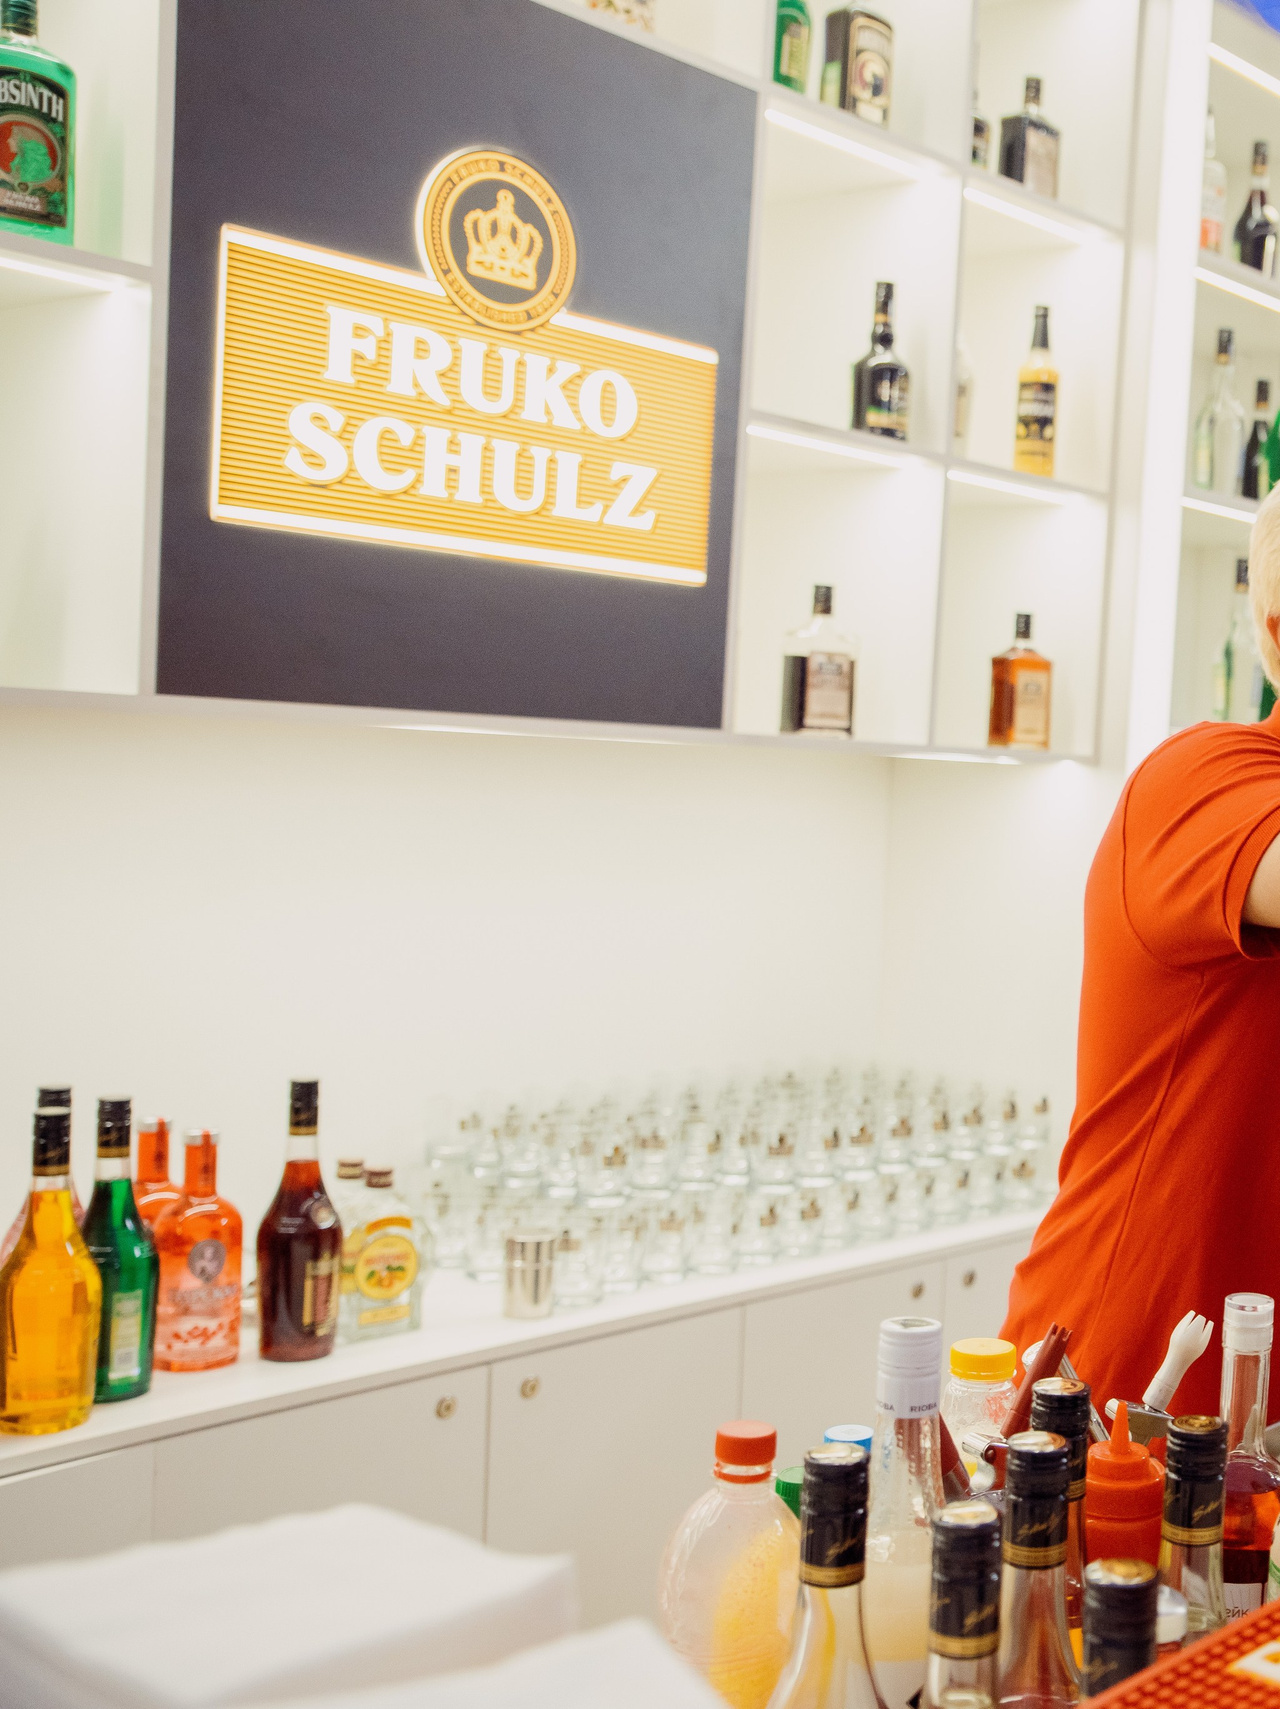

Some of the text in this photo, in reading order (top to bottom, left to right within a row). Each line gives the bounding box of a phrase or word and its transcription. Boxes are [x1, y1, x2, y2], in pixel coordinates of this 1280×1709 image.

[322, 304, 640, 440] FRUKO
[282, 401, 658, 532] SCHULZ
[909, 1402, 938, 1413] RIOBA
